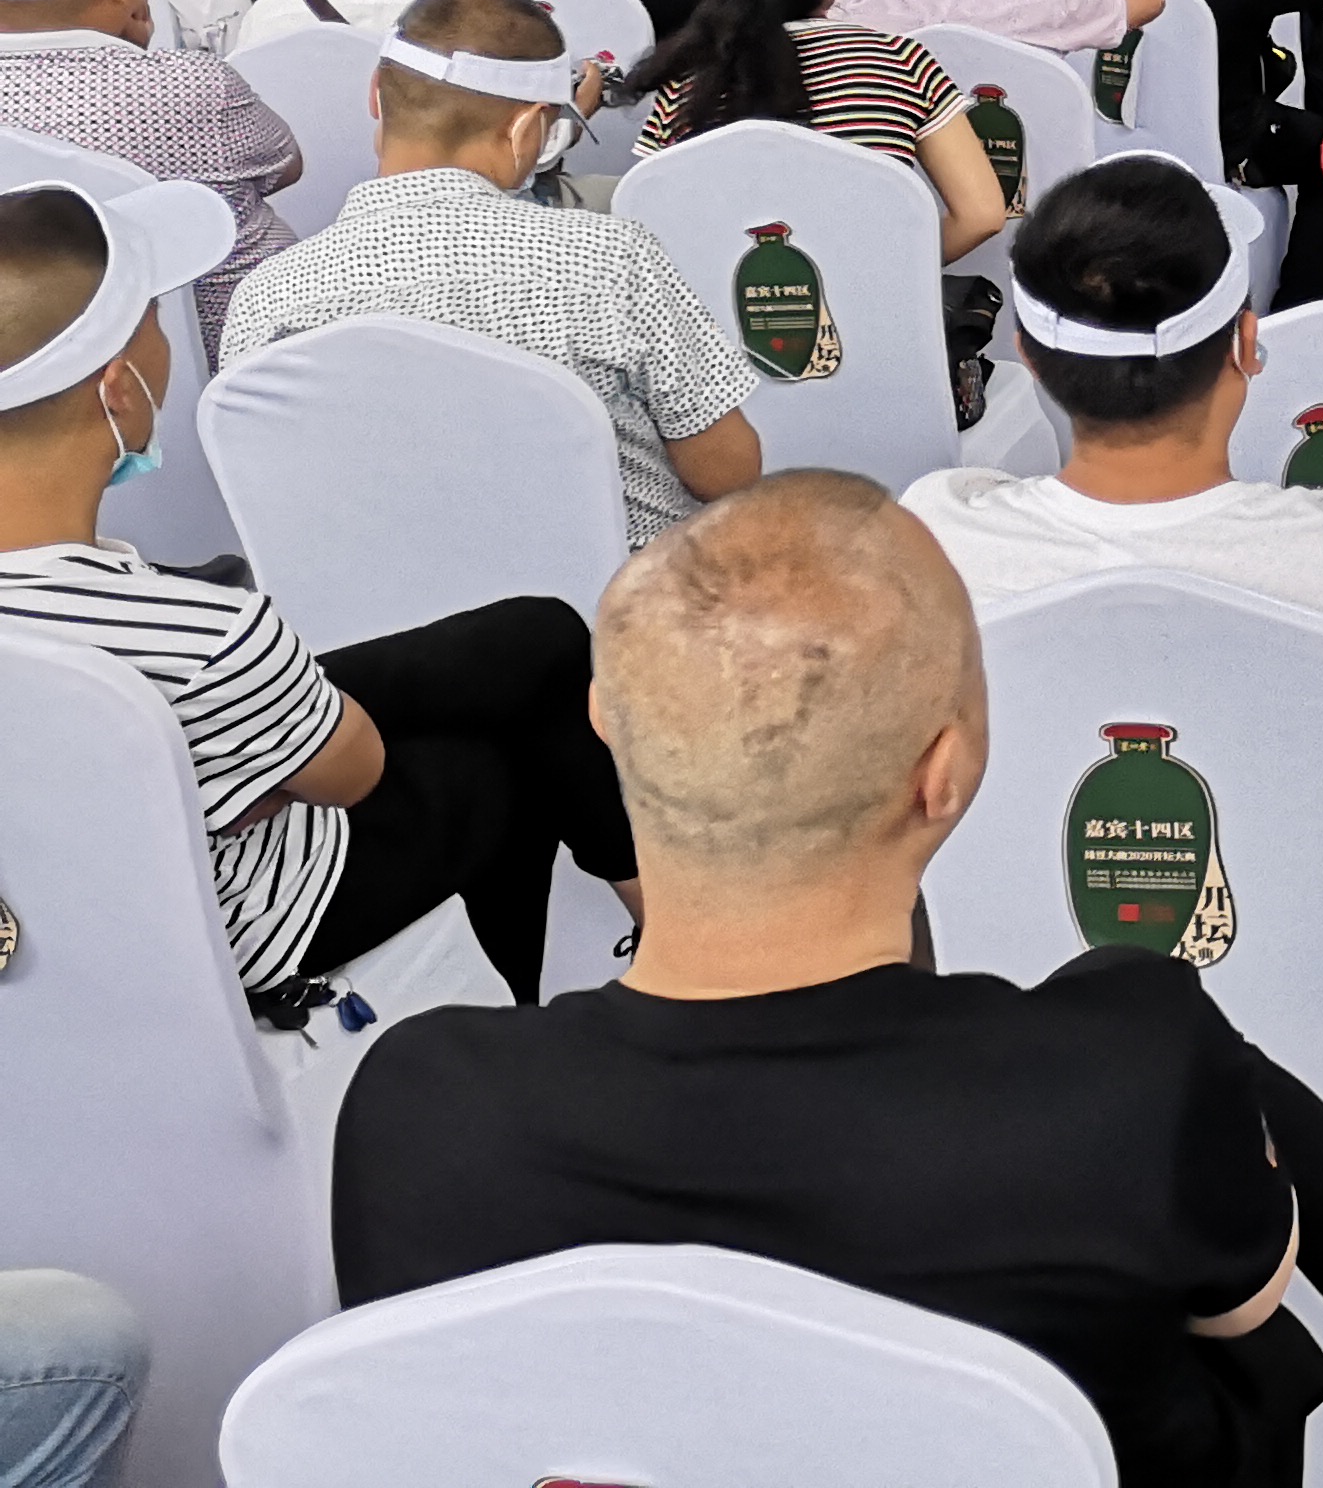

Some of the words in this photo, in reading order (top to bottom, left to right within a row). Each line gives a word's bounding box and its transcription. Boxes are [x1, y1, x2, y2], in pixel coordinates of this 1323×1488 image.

[1084, 818, 1196, 840] 嘉宾十四区
